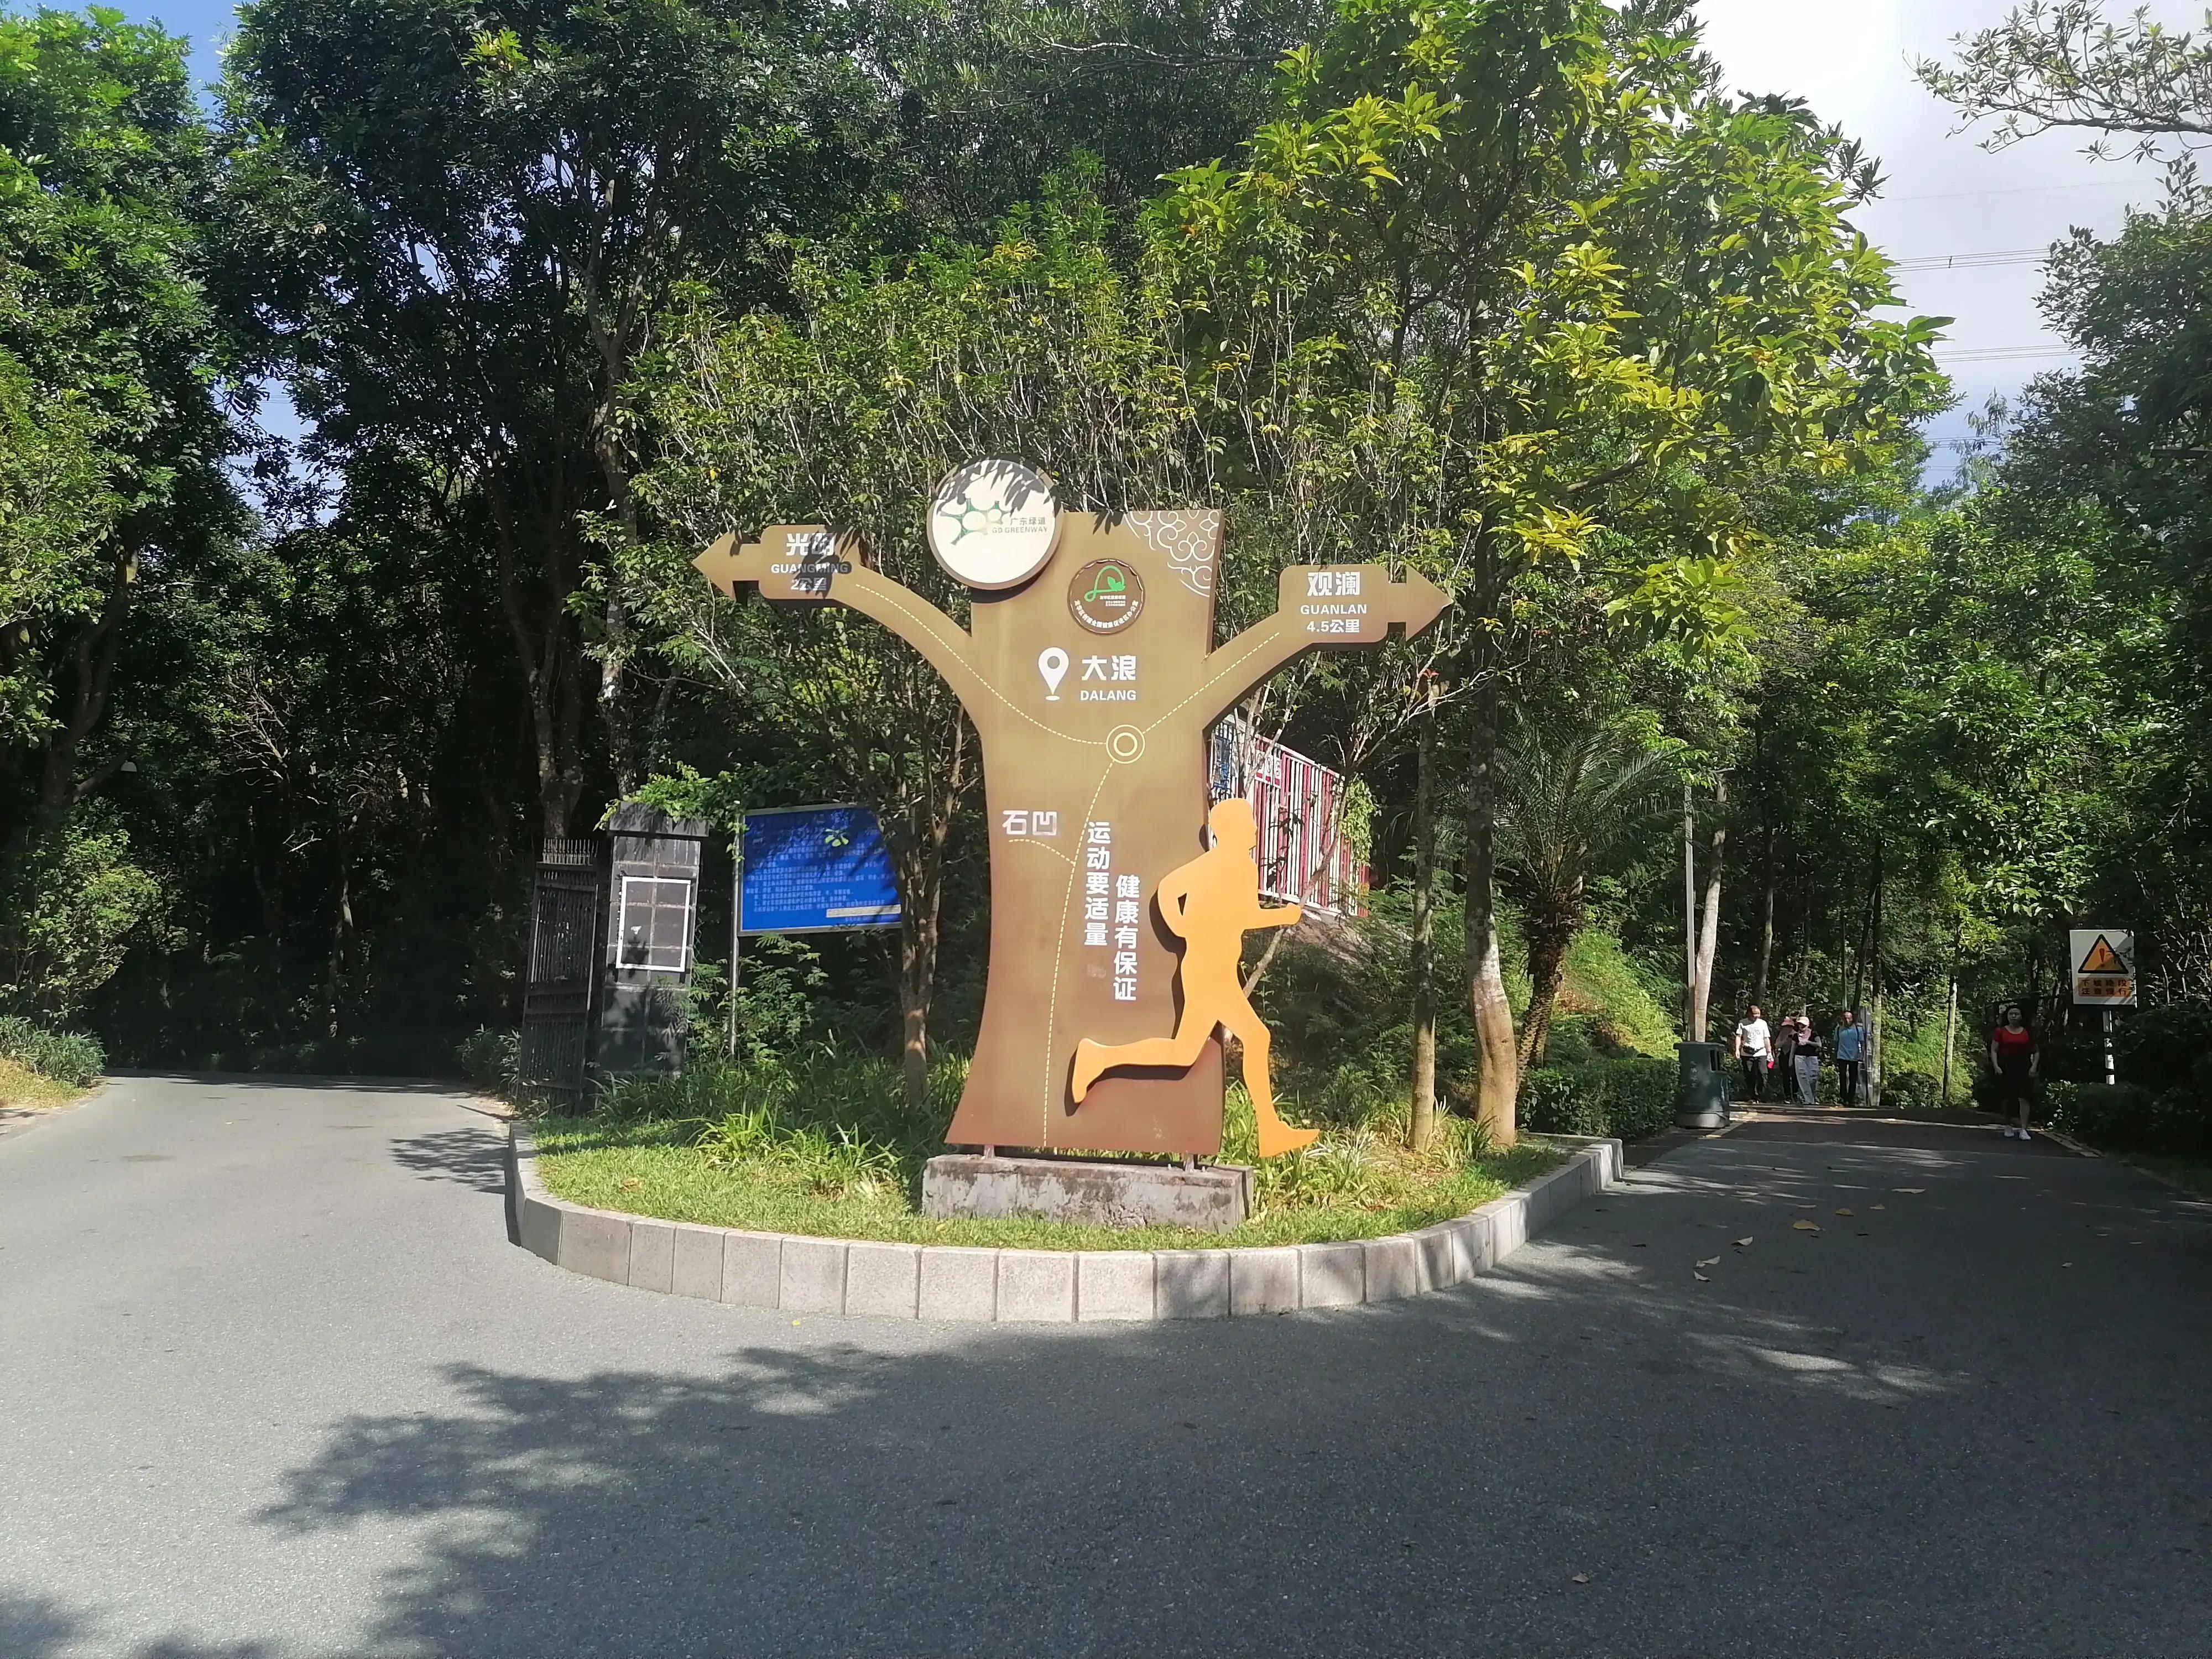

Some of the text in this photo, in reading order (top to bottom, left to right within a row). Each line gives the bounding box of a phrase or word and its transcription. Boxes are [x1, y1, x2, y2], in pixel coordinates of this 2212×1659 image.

[1010, 517, 1046, 526] 广东绿道
[786, 533, 835, 556] 光明
[771, 562, 848, 574] GUANGMING
[790, 577, 827, 591] 2公里
[1307, 571, 1360, 597] 观澜
[1300, 604, 1367, 615] GUANLAN
[1306, 619, 1360, 633] 4.5公里
[1081, 655, 1136, 681] 大浪
[1080, 690, 1136, 701] DALANG
[1002, 810, 1057, 836] 石凹
[1083, 821, 1111, 946] 运动要适量
[1113, 874, 1140, 1001] 健康有保证
